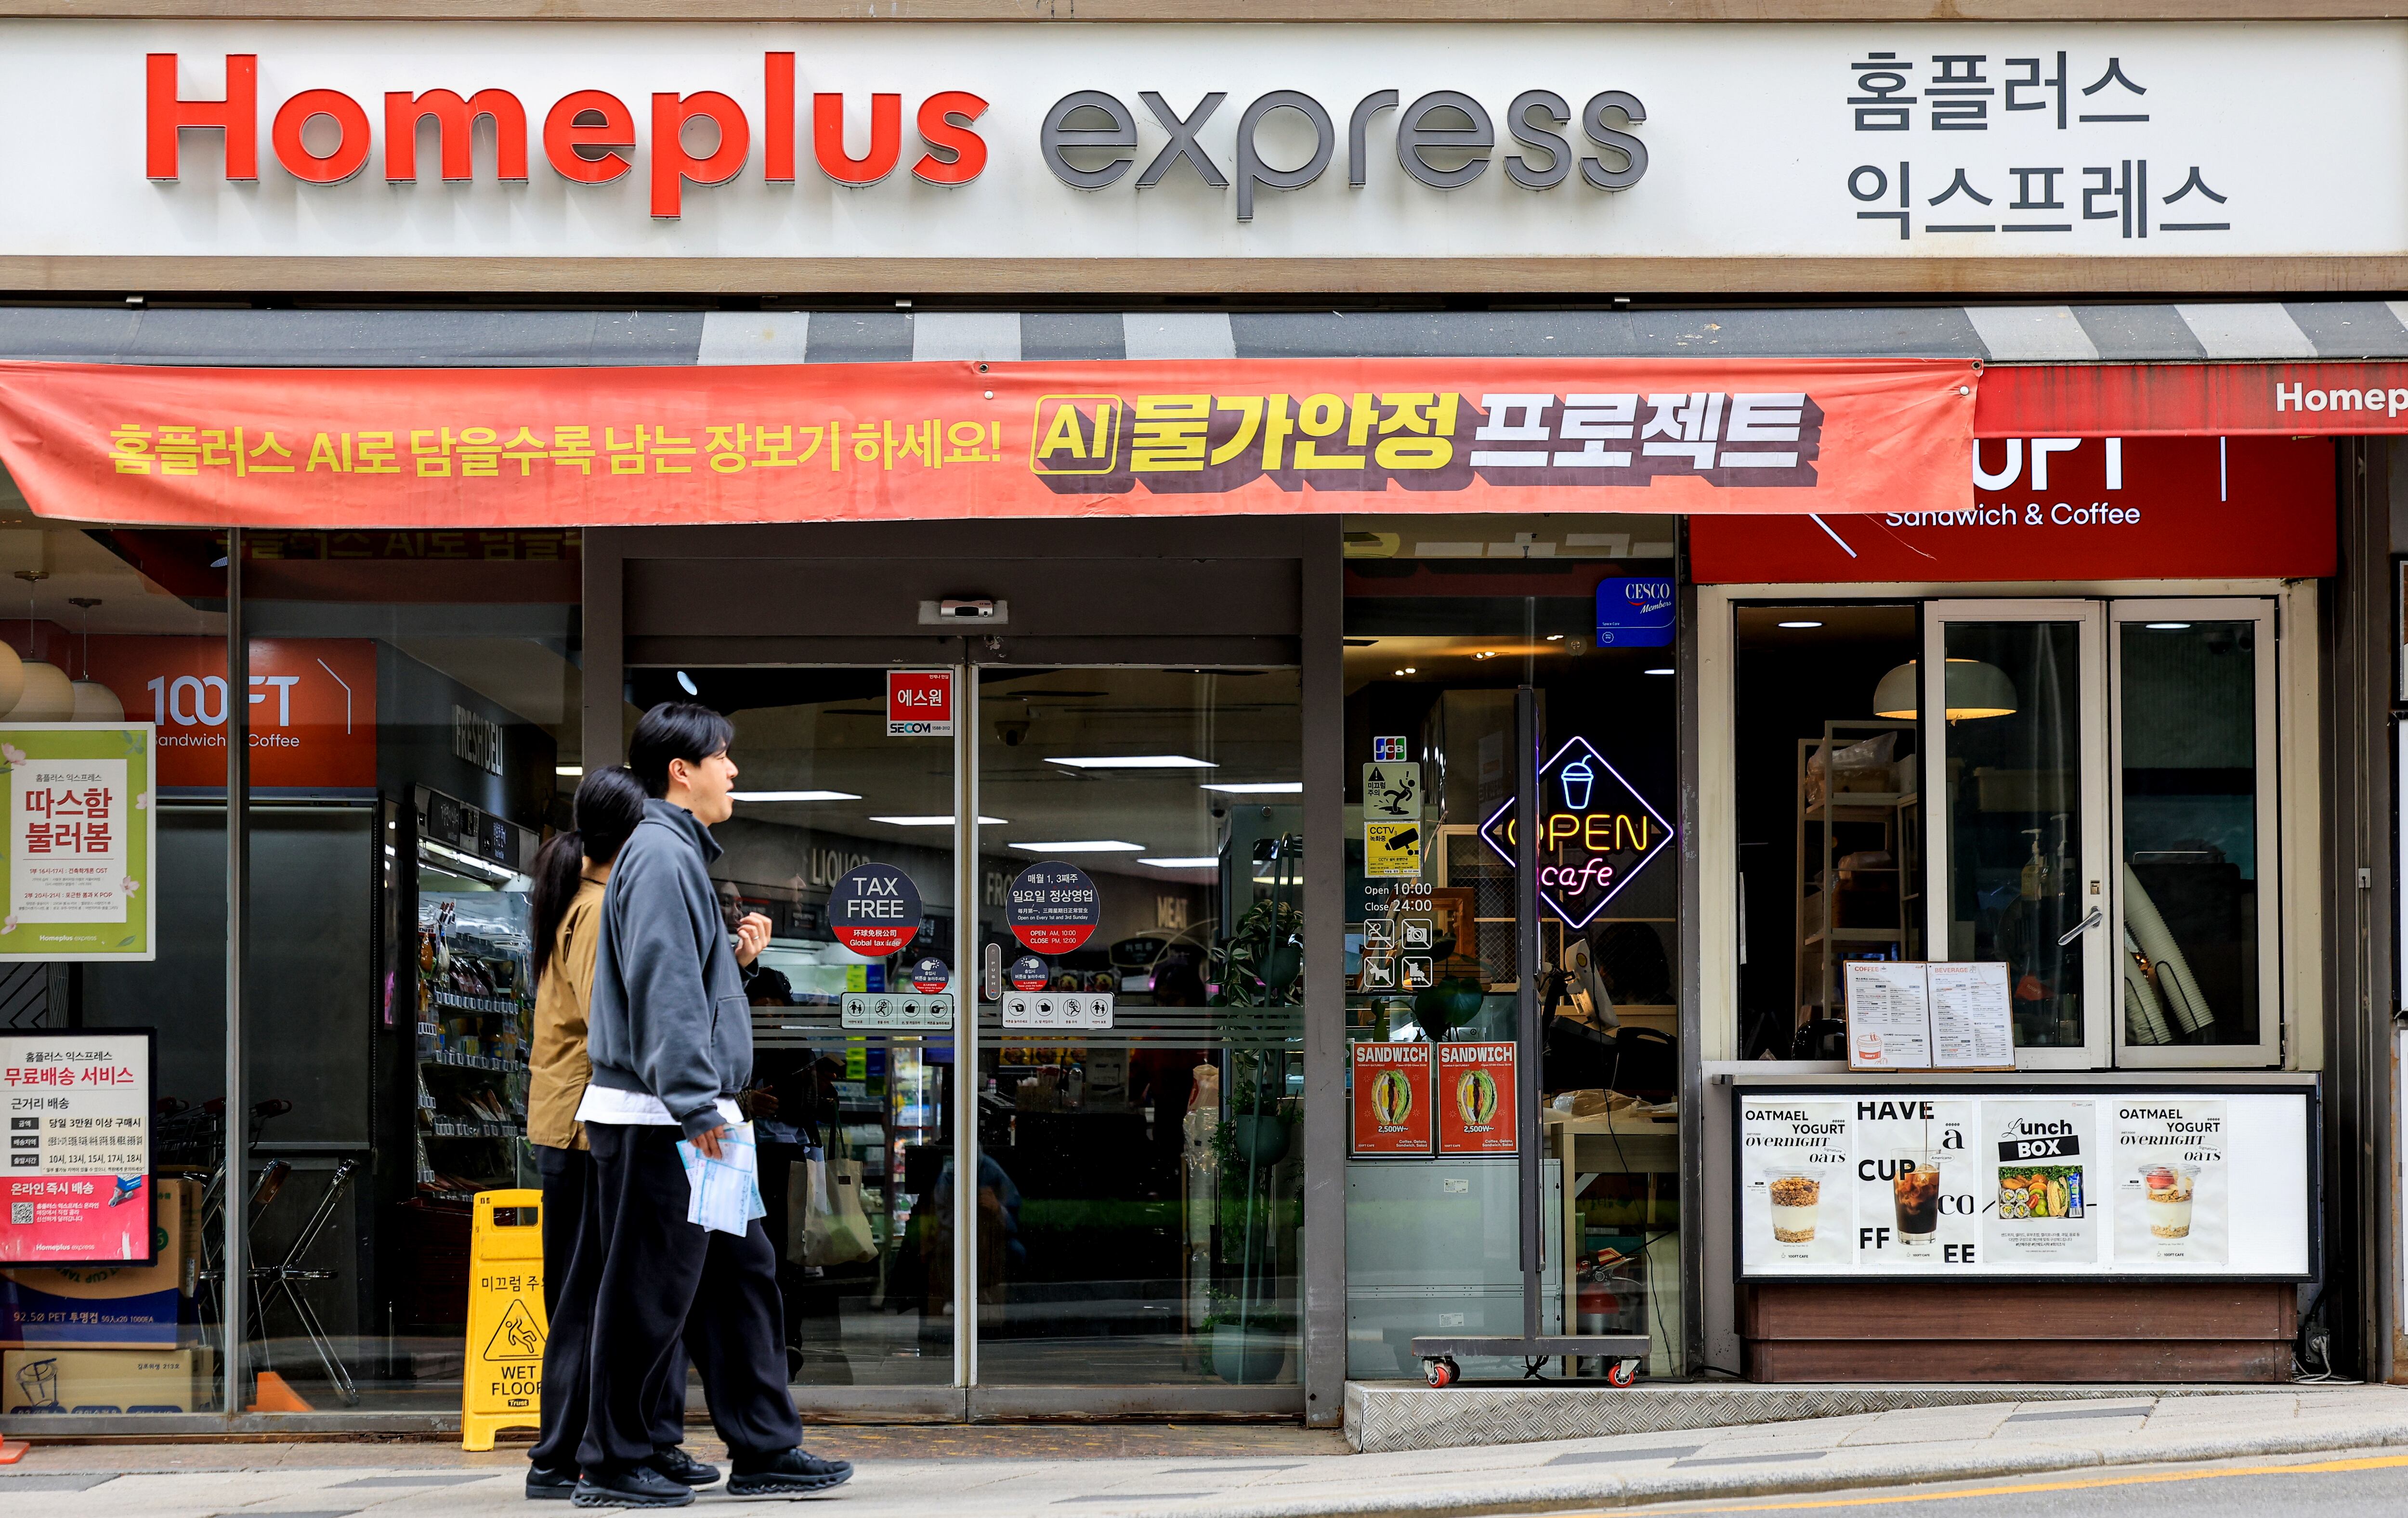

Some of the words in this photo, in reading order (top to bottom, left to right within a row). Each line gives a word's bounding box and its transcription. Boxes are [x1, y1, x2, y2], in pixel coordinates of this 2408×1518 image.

[1847, 51, 2149, 131] 홈플러스
[145, 51, 989, 220] Homeplus
[1040, 89, 1649, 221] express
[1847, 159, 2230, 240] 익스프레스
[2276, 382, 2408, 418] Homep
[1037, 403, 1108, 460] AI
[1129, 392, 1460, 472] 물가안정
[1469, 392, 1808, 470] 프로젝트
[109, 424, 295, 478] 홈플러스
[305, 430, 401, 474] AI로
[410, 425, 596, 478] 담을수록
[604, 423, 697, 475] 남는
[704, 421, 840, 473] 장보기
[851, 418, 1002, 471] 하세요!
[2025, 503, 2043, 525] &
[2051, 502, 2141, 525] Coffee
[1625, 584, 1670, 599] CESCO
[1640, 600, 1672, 614] Members
[898, 689, 942, 706] 에스원
[890, 723, 931, 733] SECOM
[249, 733, 300, 747] Coffee
[455, 704, 483, 766] FRESH
[485, 719, 503, 776] DELI
[1375, 745, 1404, 754] JCB
[35, 773, 65, 783] 홈플러스
[66, 773, 102, 782] 익스프레스
[26, 787, 112, 819] 따스함
[25, 821, 112, 854] 불러봄
[1028, 874, 1044, 883] 매월
[1047, 875, 1054, 884] 1,
[1056, 874, 1078, 883] 3째주
[1541, 857, 1613, 895] cafe
[852, 877, 899, 895] TAX
[1365, 886, 1389, 895] Open
[1394, 883, 1432, 895] 10:00
[1013, 890, 1045, 902] 일요일
[1049, 890, 1093, 903] 정상영업
[1365, 902, 1389, 911] Close
[1393, 899, 1432, 911] 24:00
[847, 899, 904, 918] FREE
[1157, 895, 1188, 929] MEAT
[26, 1052, 63, 1062] 홈플러스
[66, 1051, 113, 1061] 익스프레스
[1356, 1047, 1427, 1062] SANDWICH
[1441, 1046, 1513, 1063] SANDWICH
[4, 1067, 75, 1087] 무료배송
[81, 1066, 134, 1085] 서비스
[11, 1098, 44, 1110] 근거리
[48, 1098, 69, 1109] 배송
[1858, 1102, 1934, 1120] HAVE
[1745, 1110, 1808, 1121] OATMAEL
[2120, 1109, 2183, 1119] OATMAEL
[50, 1119, 66, 1128] 당일
[69, 1119, 93, 1128] 3만원
[95, 1118, 112, 1128] 이상
[115, 1118, 141, 1128] 구매시
[1792, 1124, 1845, 1134] YOGURT
[2002, 1118, 2072, 1141] Lunch
[2167, 1122, 2220, 1132] YOGURT
[1942, 1129, 1965, 1150] a
[2017, 1139, 2061, 1158] BOX
[49, 1155, 66, 1164] 10시,
[68, 1155, 86, 1164] 13시,
[88, 1154, 105, 1164] 15시,
[107, 1154, 125, 1164] 17시,
[127, 1154, 142, 1163] 18시
[1858, 1160, 1916, 1181] CUP
[11, 1182, 44, 1195] 온라인
[46, 1182, 68, 1195] 즉시
[71, 1181, 94, 1194] 배송
[1938, 1194, 1974, 1215] co
[1860, 1228, 1890, 1249] FF
[1944, 1245, 1975, 1263] EE
[482, 1276, 521, 1292] 미끄럼
[526, 1276, 545, 1292] 주
[48, 1312, 66, 1322] PET
[69, 1312, 98, 1324] 투명컵
[501, 1366, 537, 1379] WET
